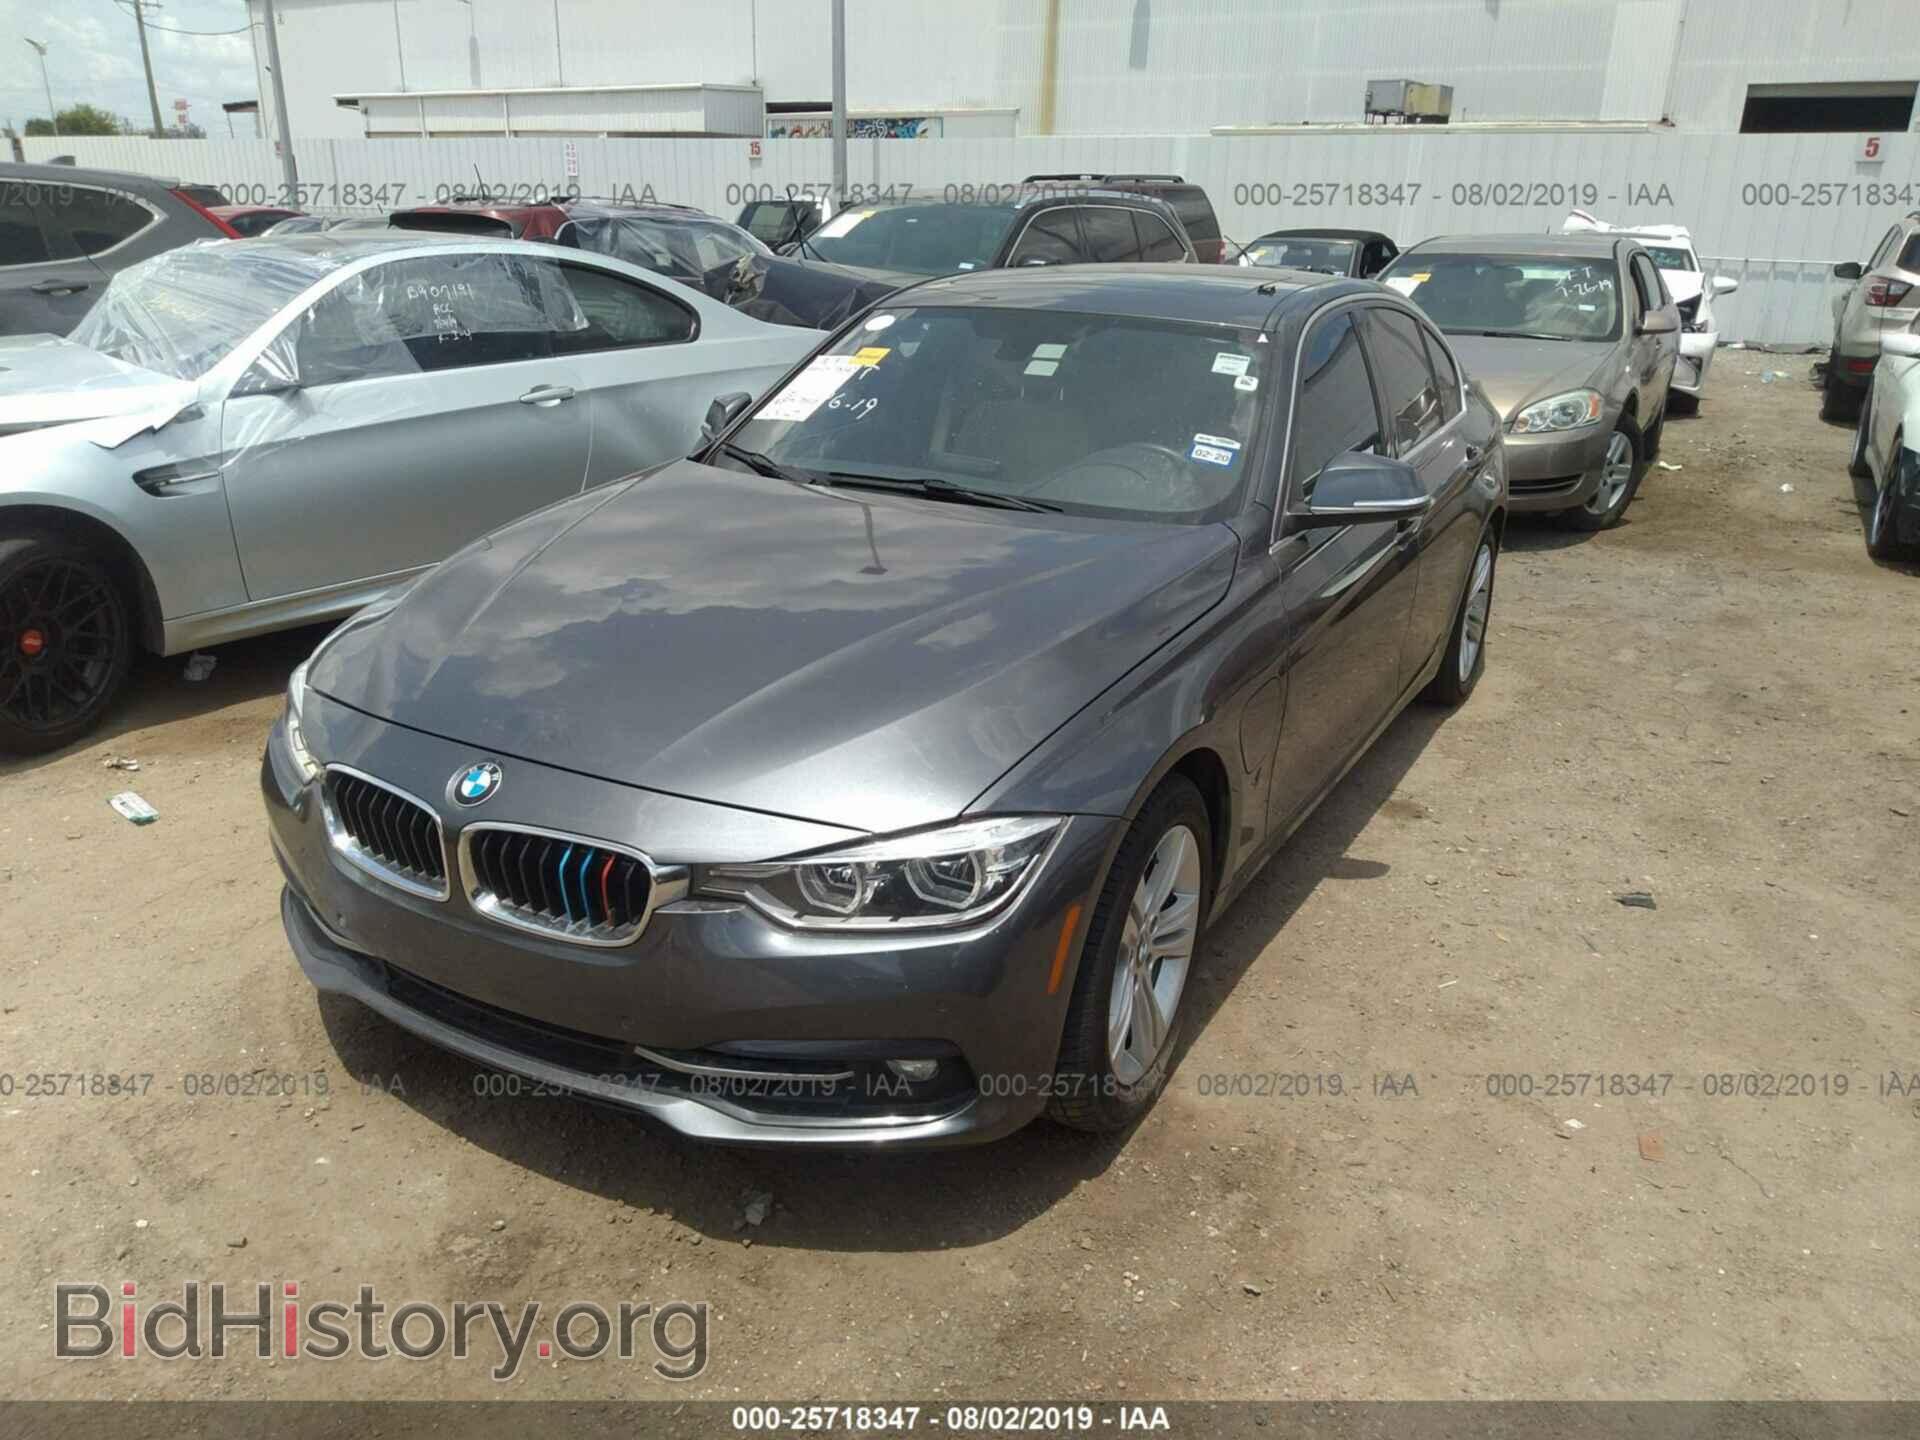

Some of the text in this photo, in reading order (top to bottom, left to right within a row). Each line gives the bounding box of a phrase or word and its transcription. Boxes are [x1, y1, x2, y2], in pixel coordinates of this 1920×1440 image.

[751, 142, 761, 156] 15
[1865, 137, 1881, 158] 5
[1195, 449, 1229, 462] 02-20
